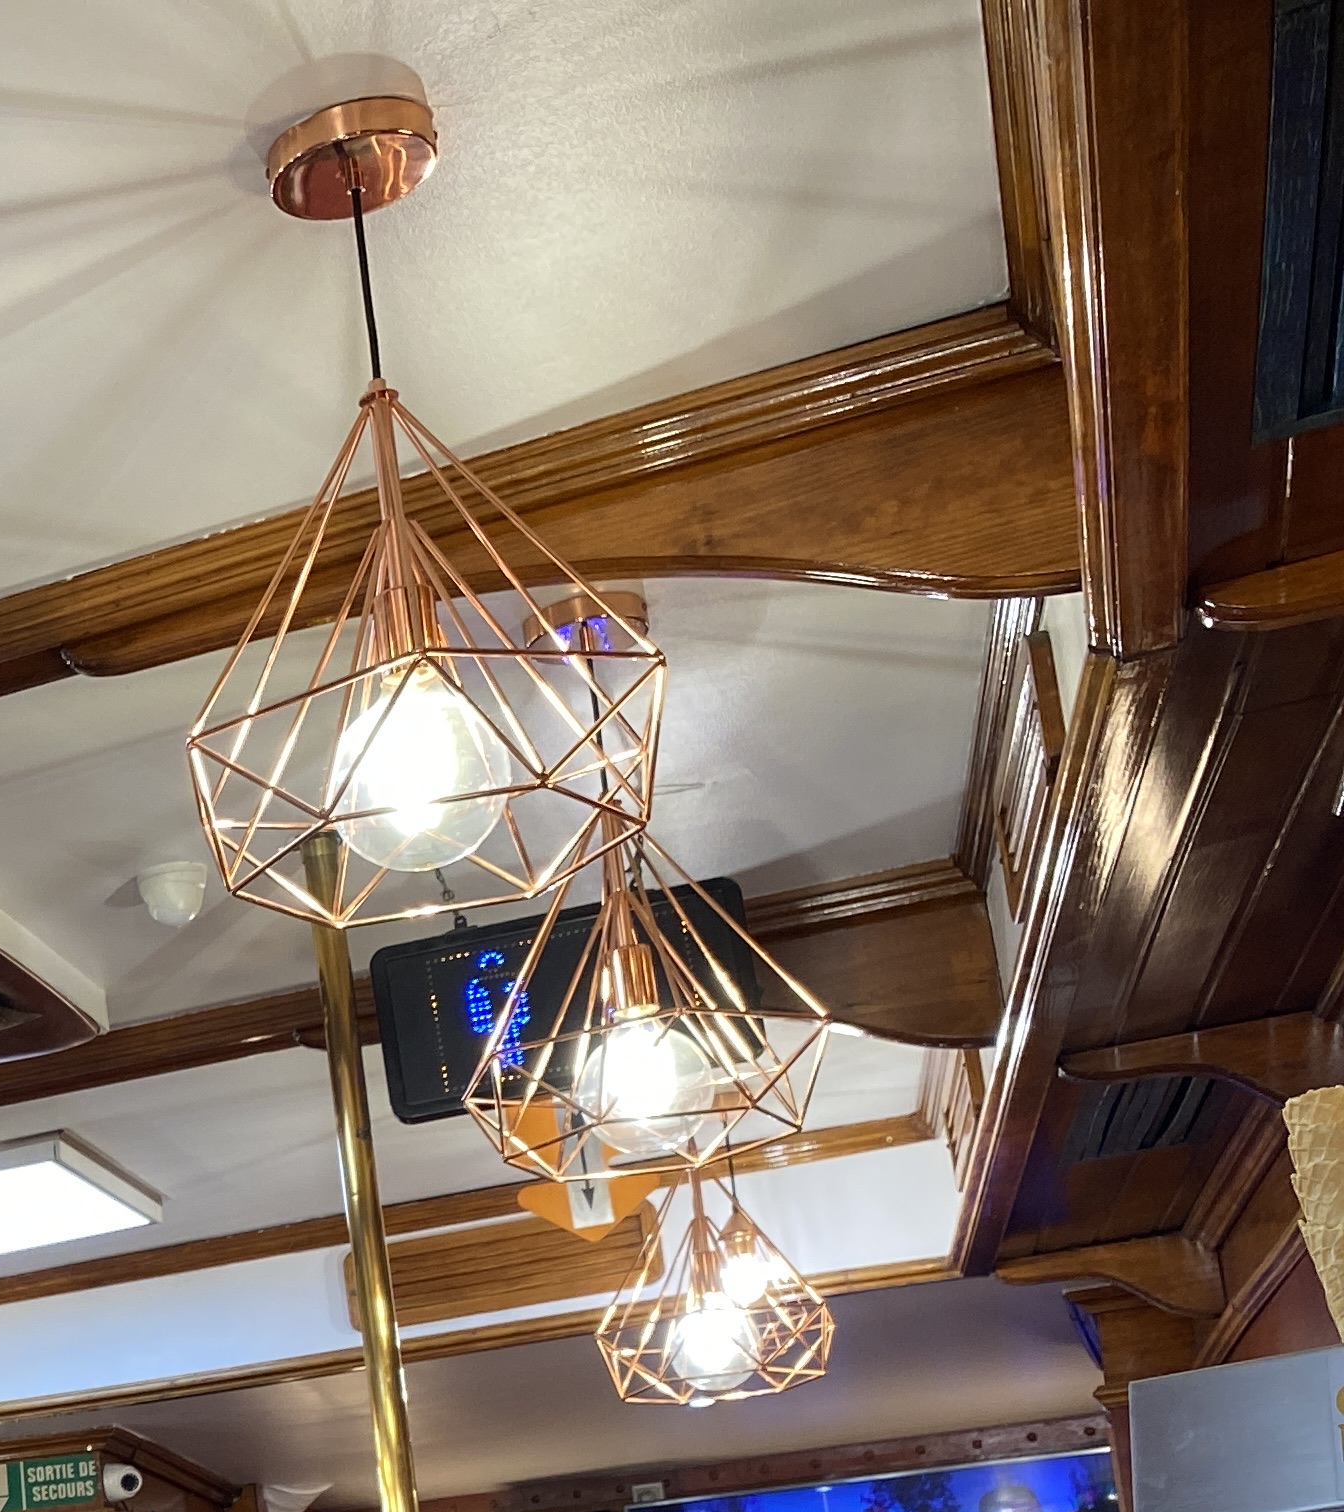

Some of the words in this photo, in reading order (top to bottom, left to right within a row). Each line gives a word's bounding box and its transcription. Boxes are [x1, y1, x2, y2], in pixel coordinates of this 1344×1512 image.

[27, 1463, 74, 1483] SORTIE
[79, 1460, 96, 1477] DE
[32, 1481, 94, 1502] SECOURS
